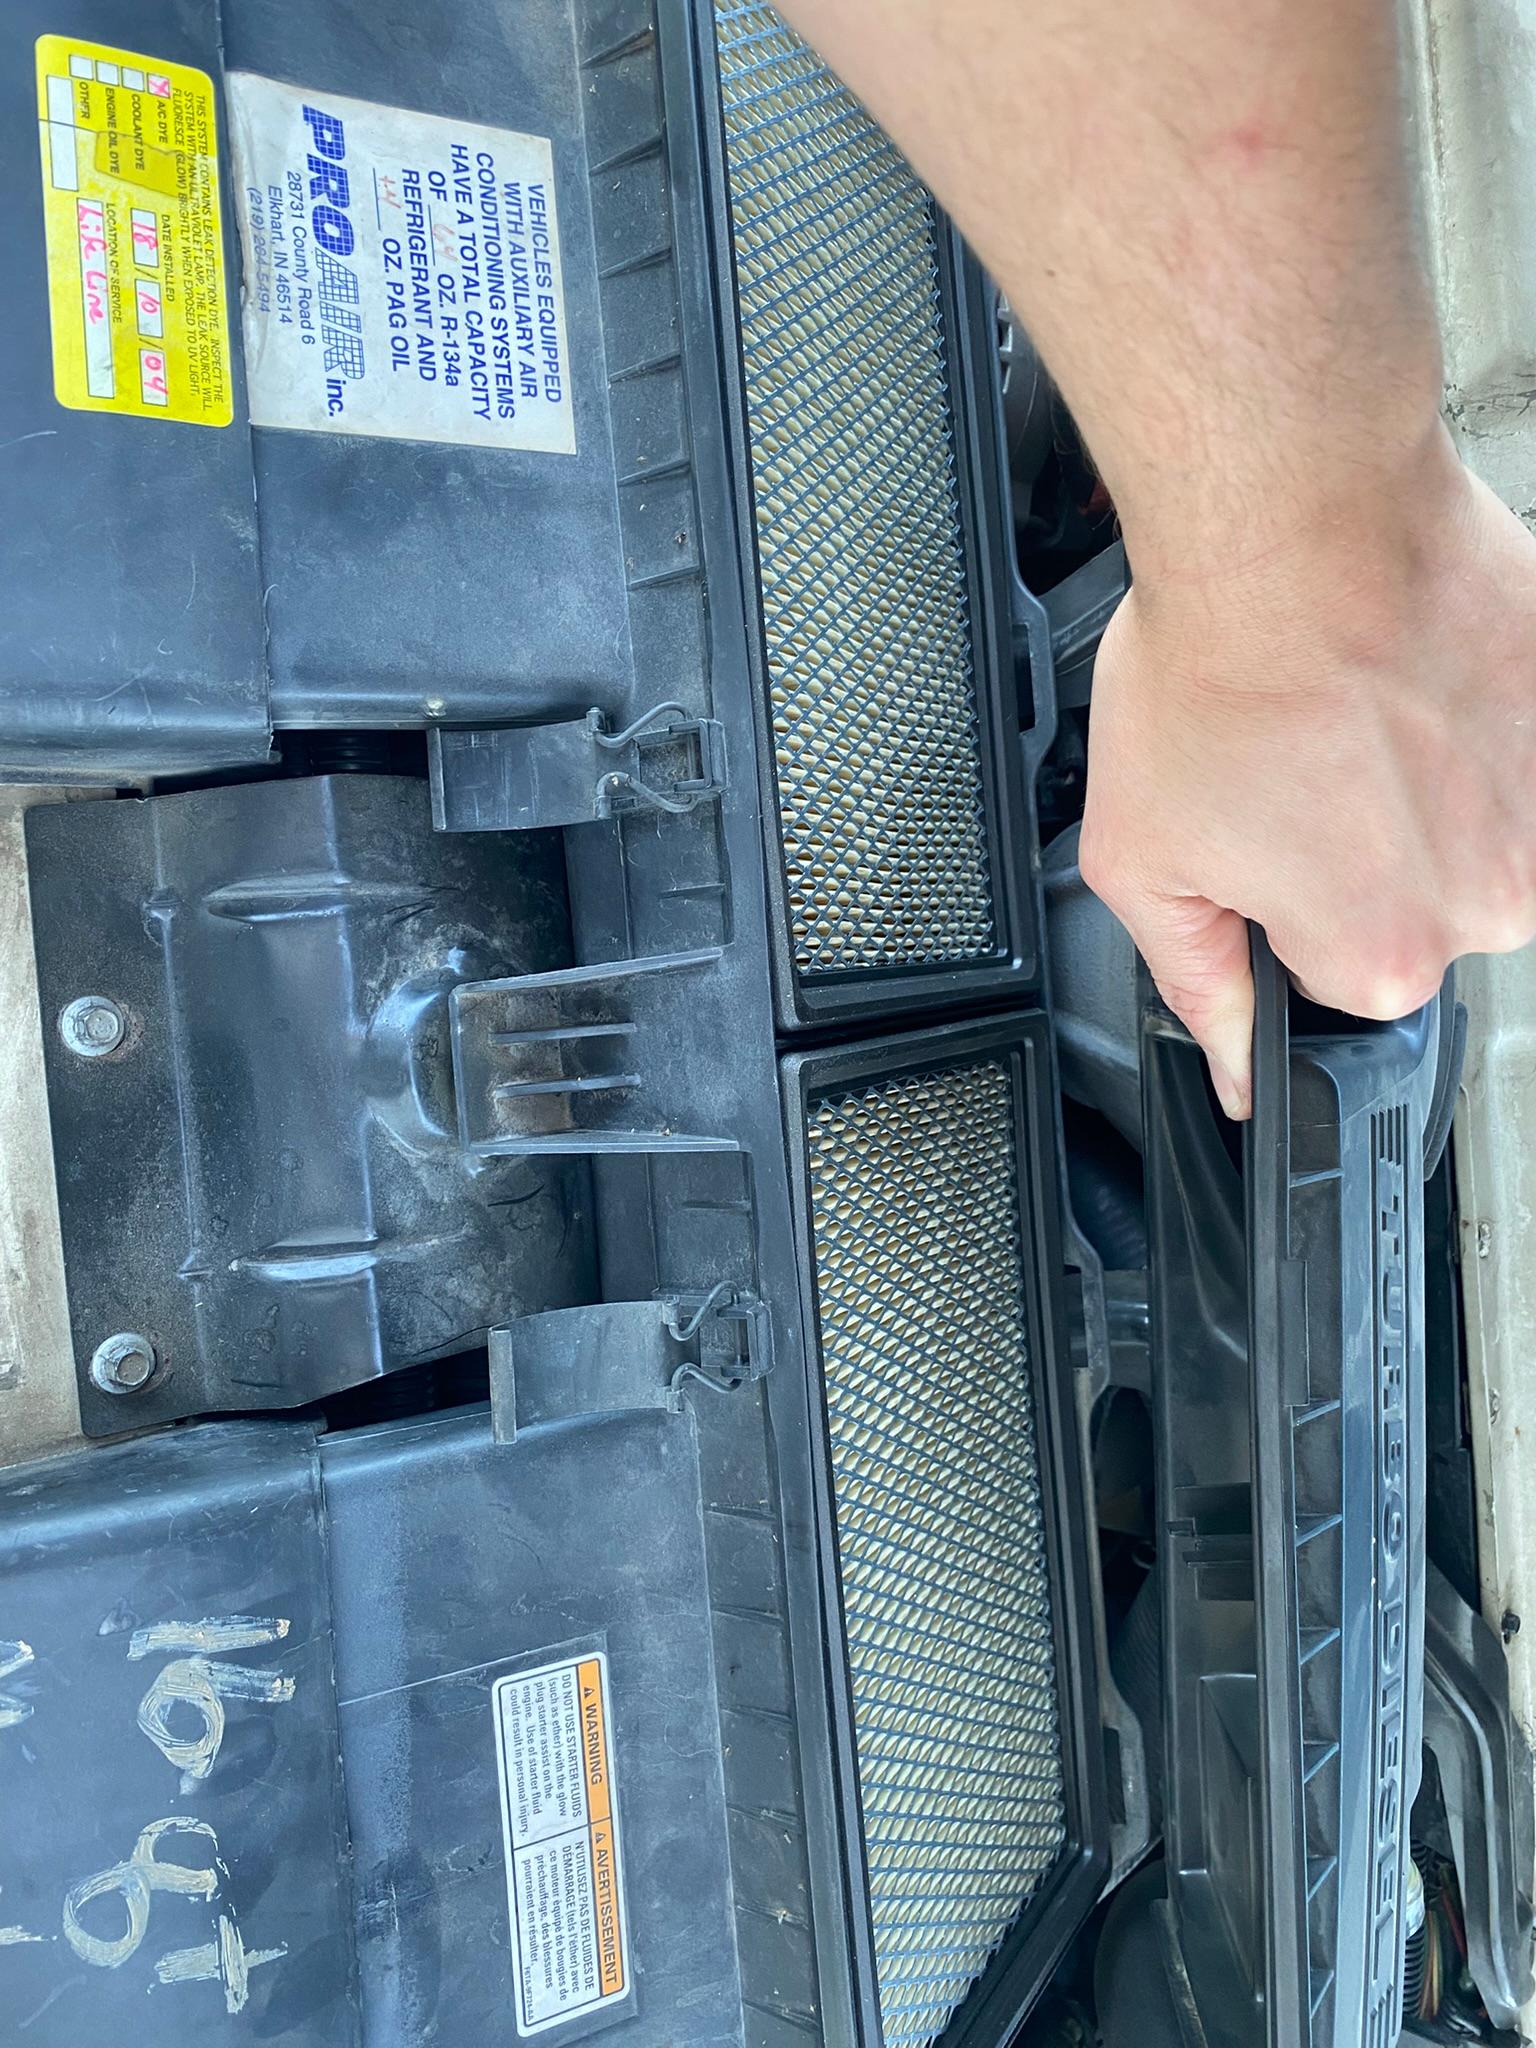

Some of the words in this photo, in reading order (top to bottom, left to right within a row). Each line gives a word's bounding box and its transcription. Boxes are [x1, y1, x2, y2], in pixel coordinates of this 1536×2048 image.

[105, 87, 116, 128] ENGINE
[132, 93, 143, 146] COOLANT
[157, 101, 166, 118] A/C
[173, 88, 184, 146] FLUORESCE
[184, 91, 196, 133] SYSTEM
[197, 95, 206, 116] THIS
[109, 130, 118, 148] OIL
[159, 122, 167, 143] DYE
[186, 135, 197, 161] WITH
[198, 120, 208, 161] SYSTEM
[109, 151, 119, 174] DYE
[135, 148, 144, 171] DYE
[175, 150, 187, 189] (GLOW)
[189, 164, 198, 180] AN
[451, 144, 472, 204] HAVE
[199, 162, 212, 215] CONTAINS
[287, 171, 305, 218] 28731
[428, 171, 447, 202] OF
[178, 192, 190, 244] BRIGHTLY
[189, 183, 204, 251] ULTRAVIOLET
[247, 187, 265, 230] (219)
[268, 185, 284, 245] Elkhart,
[457, 210, 474, 224] A
[504, 182, 524, 235] WITH
[106, 203, 120, 257] LOCATION
[161, 214, 172, 242] DATE
[203, 219, 213, 245] LEAK
[528, 184, 552, 288] VEHICLES
[181, 246, 191, 276] WHEN
[273, 252, 288, 268] IN
[292, 226, 309, 282] County
[383, 238, 402, 272] OZ.
[402, 169, 432, 328] REFRIGERANT
[110, 260, 120, 276] OF
[163, 244, 174, 302] INSTALLED
[205, 249, 217, 306] DETECTION
[459, 233, 481, 303] TOTAL
[110, 277, 122, 324] SERVICE
[196, 292, 206, 311] THE
[276, 274, 292, 323] 46514
[437, 274, 456, 307] OZ.
[476, 152, 506, 311] CONDITIONING
[491, 317, 515, 419] SYSTEMS
[509, 240, 535, 356] AUXILIARY
[139, 292, 160, 314] 10
[183, 279, 195, 325] EXPOSED
[298, 287, 314, 330] Road
[386, 282, 407, 328] PAG
[198, 314, 208, 340] LEAK
[209, 309, 219, 331] DYE.
[187, 330, 197, 344] TO
[188, 346, 198, 360] UV
[302, 335, 315, 344] 6
[440, 316, 461, 386] R-134a
[538, 295, 562, 403] EQUIPPED
[199, 344, 211, 384] SOURCE
[210, 338, 222, 381] INSPECT
[391, 336, 410, 372] OIL
[416, 334, 435, 381] AND
[465, 310, 491, 420] CAPACITY
[189, 365, 200, 397] LIGHT.
[214, 384, 223, 403] THE
[519, 361, 537, 398] AIR
[202, 387, 212, 411] WILL
[326, 378, 346, 417] inc.
[1381, 1193, 1408, 1558] TURBO
[535, 1681, 545, 1703] plug
[548, 1677, 559, 1704] (such
[562, 1674, 572, 1688] DO
[510, 1688, 521, 1716] could
[521, 1685, 534, 1721] engine.
[551, 1706, 559, 1718] as
[563, 1691, 574, 1712] NOT
[513, 1718, 523, 1747] result
[526, 1725, 536, 1744] Use
[538, 1704, 548, 1737] starter
[552, 1720, 563, 1749] ether)
[565, 1714, 575, 1735] USE
[515, 1749, 525, 1758] in
[528, 1747, 537, 1757] of
[541, 1739, 550, 1767] assist
[566, 1737, 580, 1780] STARTER
[585, 1703, 602, 1786] WARNING
[528, 1758, 540, 1790] starter
[543, 1770, 551, 1781] on
[554, 1750, 564, 1772] with
[513, 1761, 528, 1802] personal
[544, 1783, 554, 1799] the
[556, 1774, 566, 1790] the
[1372, 1601, 1404, 1984] DIESEL
[532, 1792, 542, 1815] fluid
[555, 1792, 568, 1817] glow
[570, 1783, 582, 1818] FLUIDS
[518, 1805, 530, 1837] injury.
[549, 1850, 557, 1862] ce
[521, 1859, 535, 1910] pourraient
[550, 1864, 560, 1898] moteur
[562, 1846, 576, 1909] DÉMARRAGE
[527, 1911, 535, 1924] en
[551, 1899, 563, 1933] équipé
[566, 1910, 576, 1932] (tels
[579, 1897, 590, 1917] PAS
[596, 1849, 617, 1984] AVERTISSEMENT
[541, 1923, 550, 1940] des
[555, 1935, 564, 1947] de
[581, 1919, 590, 1933] DE
[542, 1941, 553, 1989] blessures
[554, 1948, 567, 1987] bougies
[581, 1935, 593, 1975] FLUIDES
[559, 1988, 568, 2001] de
[571, 1970, 579, 1993] avec
[584, 1976, 594, 1991] DE
